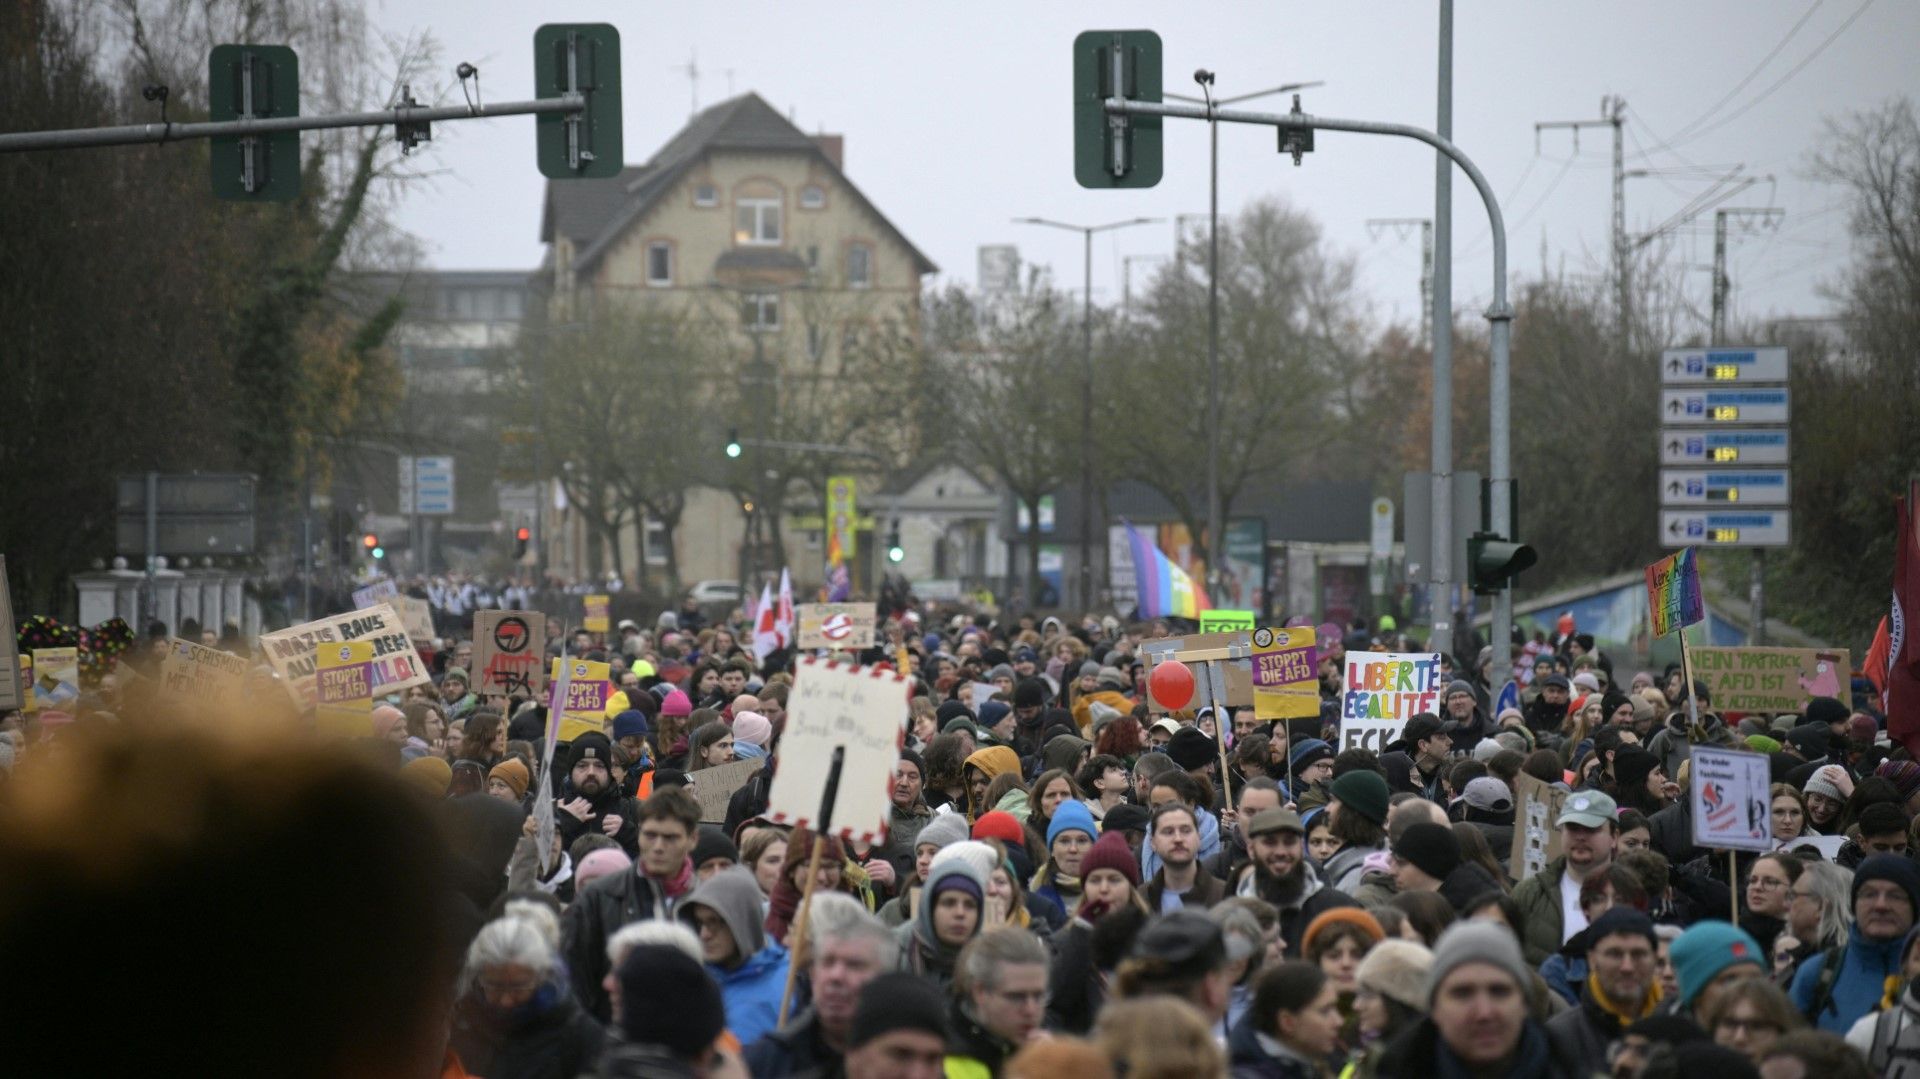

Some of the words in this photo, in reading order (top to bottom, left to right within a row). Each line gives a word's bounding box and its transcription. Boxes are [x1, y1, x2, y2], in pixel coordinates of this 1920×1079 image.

[272, 627, 336, 659] NAZIS
[338, 613, 386, 641] RAUS
[1258, 650, 1308, 671] STOPPT
[1690, 651, 1733, 669] NEIN
[322, 665, 366, 688] STOPPT
[1261, 668, 1283, 685] DIE
[1285, 664, 1311, 681] AFD
[1348, 653, 1441, 692] LIBERTÉ
[1718, 672, 1755, 690] AFD
[325, 686, 345, 701] DIE
[345, 681, 368, 698] AFD
[577, 696, 601, 709] AFD
[1344, 688, 1437, 720] ÉGALITÉ
